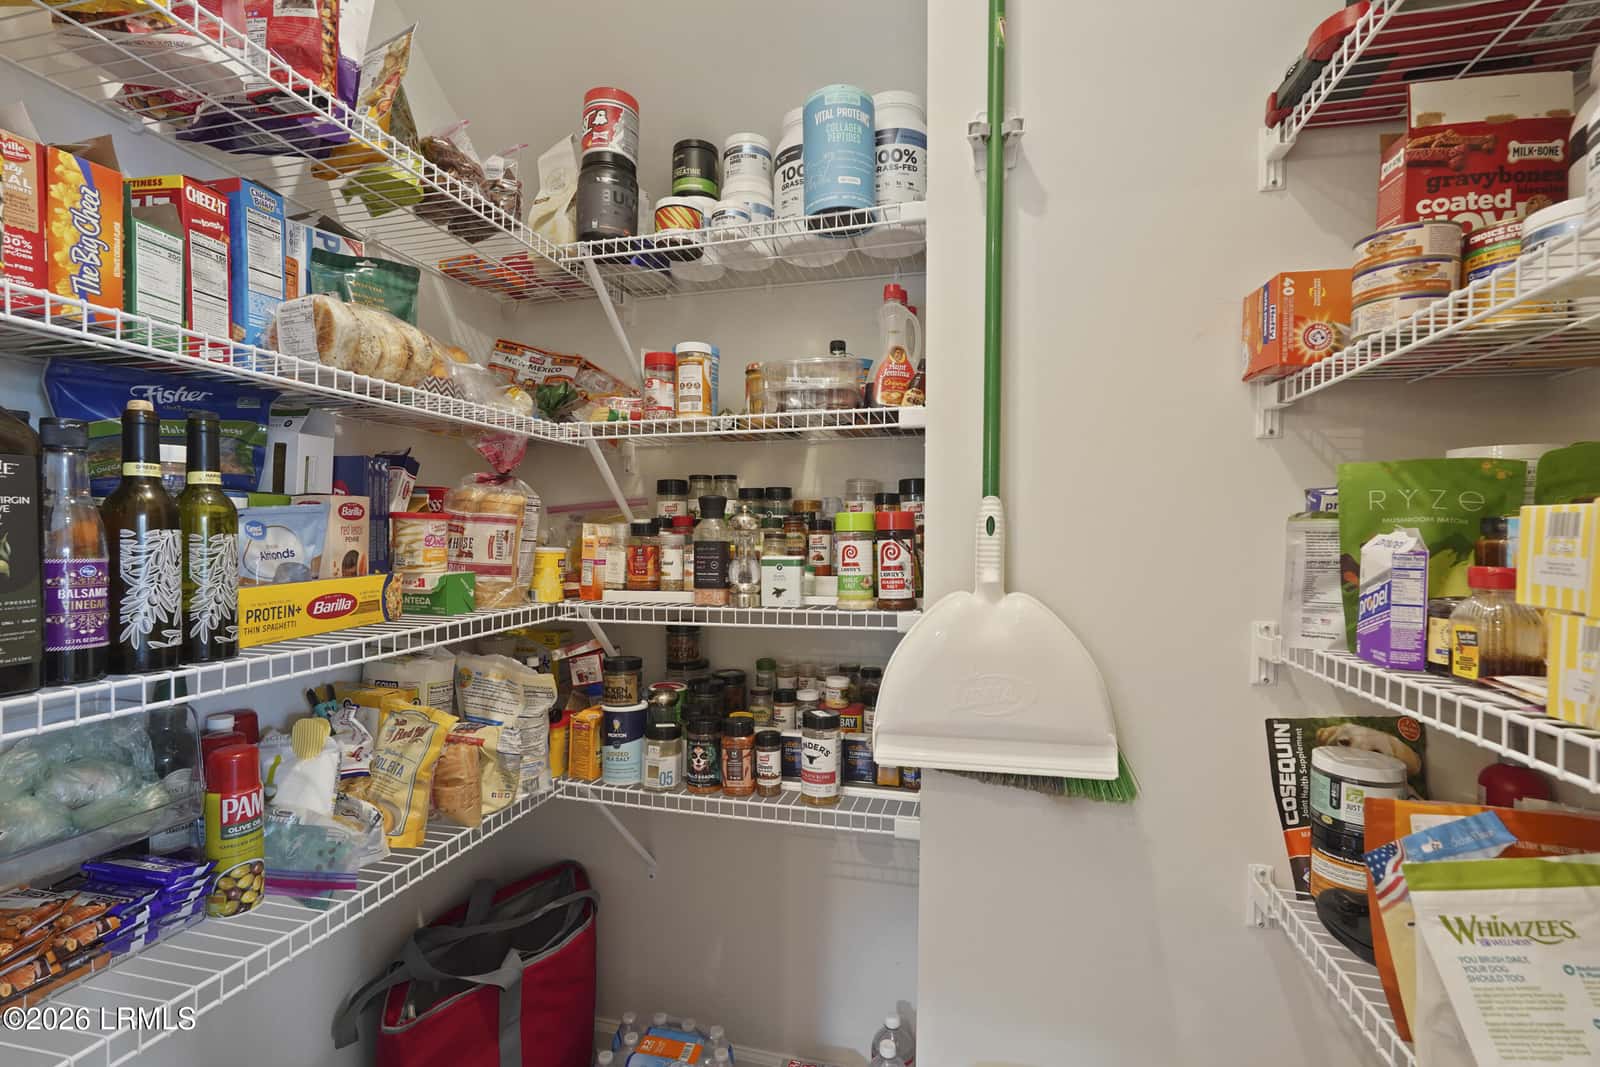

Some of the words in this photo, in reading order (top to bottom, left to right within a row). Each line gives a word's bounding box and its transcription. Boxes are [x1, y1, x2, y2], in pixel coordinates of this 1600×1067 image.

[814, 109, 834, 126] VITAL
[185, 185, 227, 217] CHEEZ-IT
[1416, 189, 1512, 214] coated
[70, 237, 109, 267] Big
[70, 266, 102, 296] The
[528, 363, 562, 374] MEXICO
[130, 384, 214, 404] Fisher
[259, 548, 296, 561] Almonds
[313, 598, 353, 615] Barilla
[1359, 583, 1389, 618] propel
[245, 603, 302, 625] PROTEIN+
[243, 627, 261, 636] THIN
[262, 621, 297, 633] SPAGHETTI
[1296, 728, 1308, 774] Supplement
[659, 771, 674, 786] 05
[1273, 721, 1301, 826] COSEQUIN
[1299, 775, 1310, 799] Health
[222, 788, 265, 825] PAM
[228, 822, 252, 834] OLIVE
[1438, 914, 1578, 947] WHIMZEES
